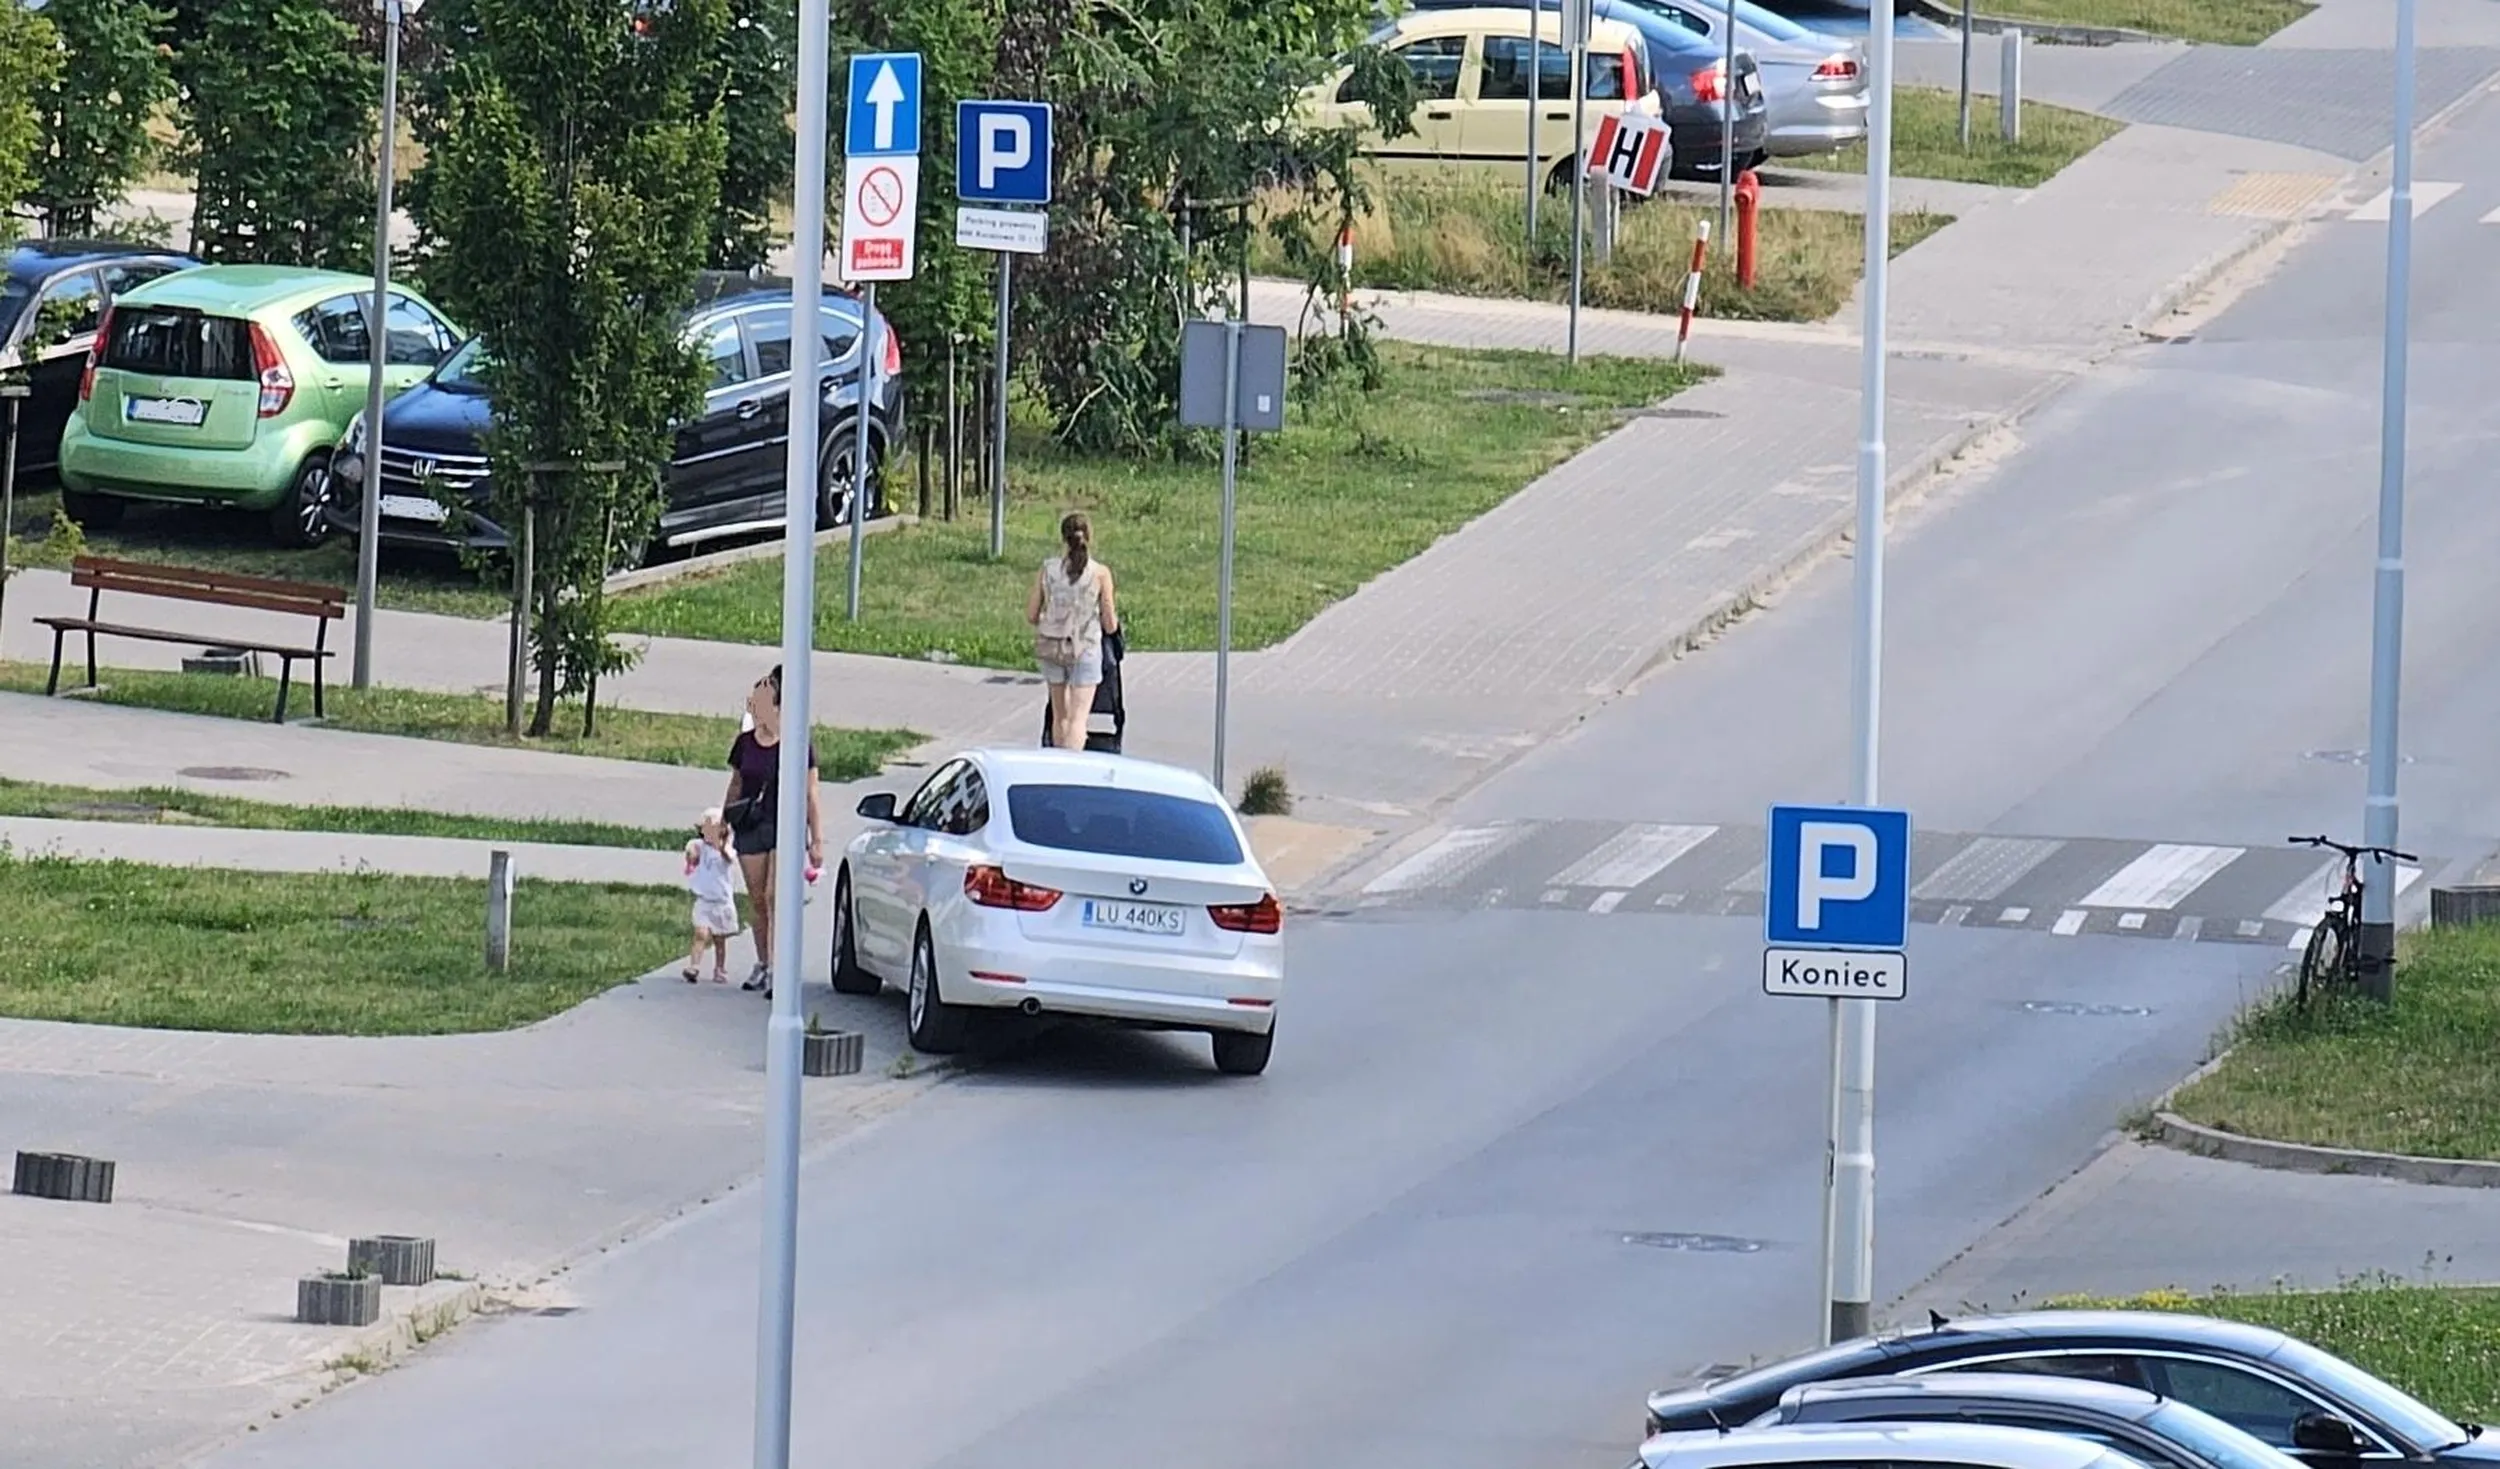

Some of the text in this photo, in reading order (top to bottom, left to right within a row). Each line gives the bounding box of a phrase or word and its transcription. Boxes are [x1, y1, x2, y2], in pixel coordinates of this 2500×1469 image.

[979, 112, 1031, 189] P
[1608, 126, 1645, 179] H
[1798, 821, 1878, 930] P
[1096, 904, 1180, 930] LU 440KS
[1781, 958, 1888, 988] Koniec
